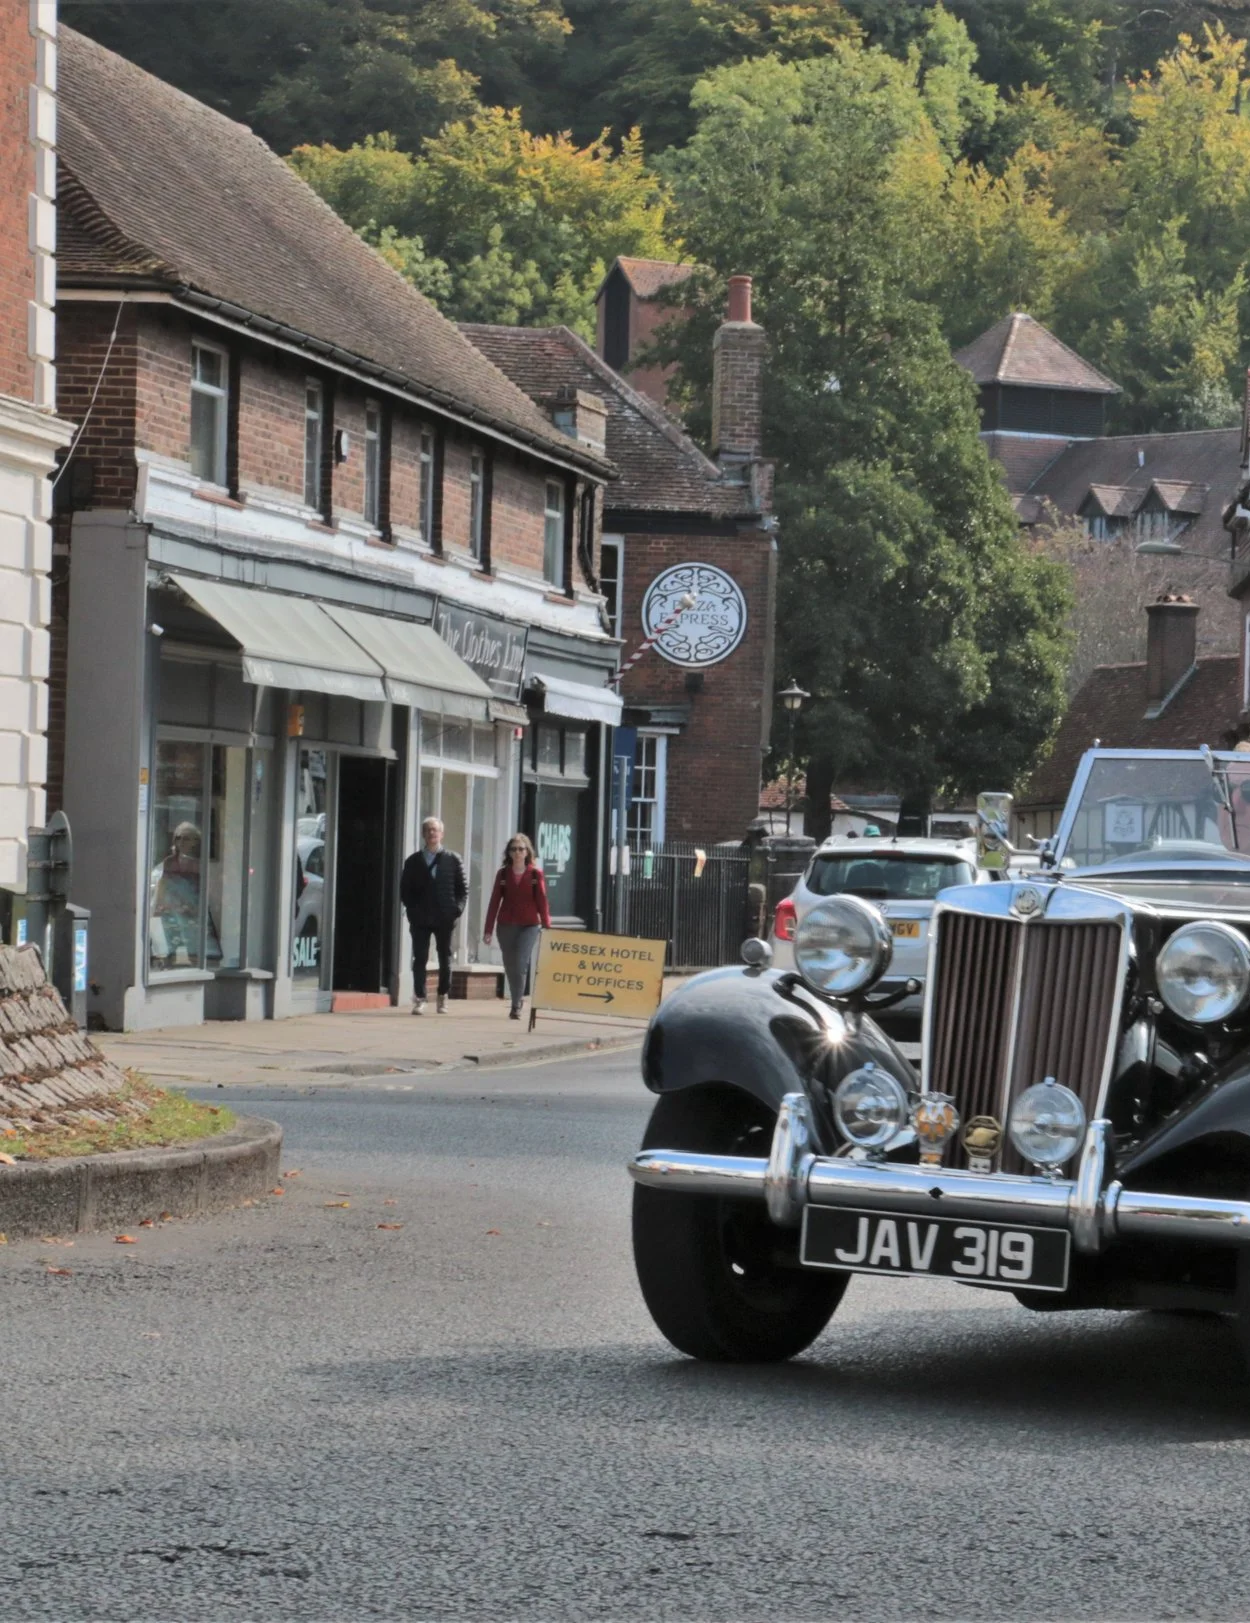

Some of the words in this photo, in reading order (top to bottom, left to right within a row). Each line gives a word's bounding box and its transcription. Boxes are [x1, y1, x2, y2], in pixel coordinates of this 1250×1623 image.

[659, 612, 729, 626] EPRESS
[462, 620, 502, 668] Clothes
[292, 936, 319, 968] SALE
[550, 941, 606, 956] WESSEX
[610, 948, 655, 962] HOTEL
[577, 960, 587, 970] &
[591, 961, 623, 973] WCC
[552, 972, 585, 983] CITY
[586, 976, 645, 991] OFFICES
[834, 1216, 940, 1271] JAV
[951, 1226, 1035, 1281] 319
